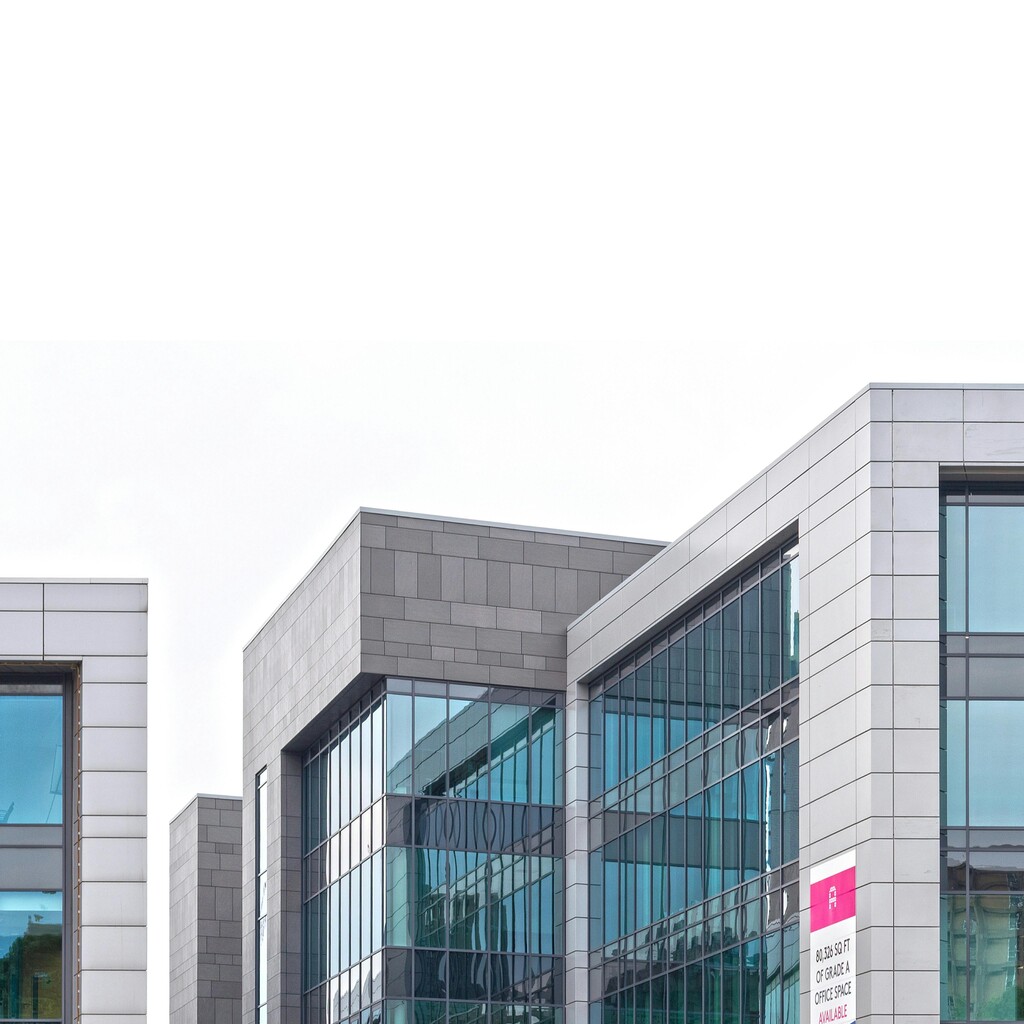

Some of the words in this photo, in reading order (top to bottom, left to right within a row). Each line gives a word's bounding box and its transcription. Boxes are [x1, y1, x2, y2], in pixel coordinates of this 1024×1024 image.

[816, 945, 833, 963] 80,326
[834, 941, 842, 956] SQ
[844, 938, 850, 953] FT
[816, 969, 824, 984] OF
[825, 962, 844, 981] GRADE
[845, 960, 850, 974] A
[815, 987, 833, 1005] OFFICE
[834, 981, 852, 999] SPACE
[818, 1004, 848, 1024] AVAILABLE
